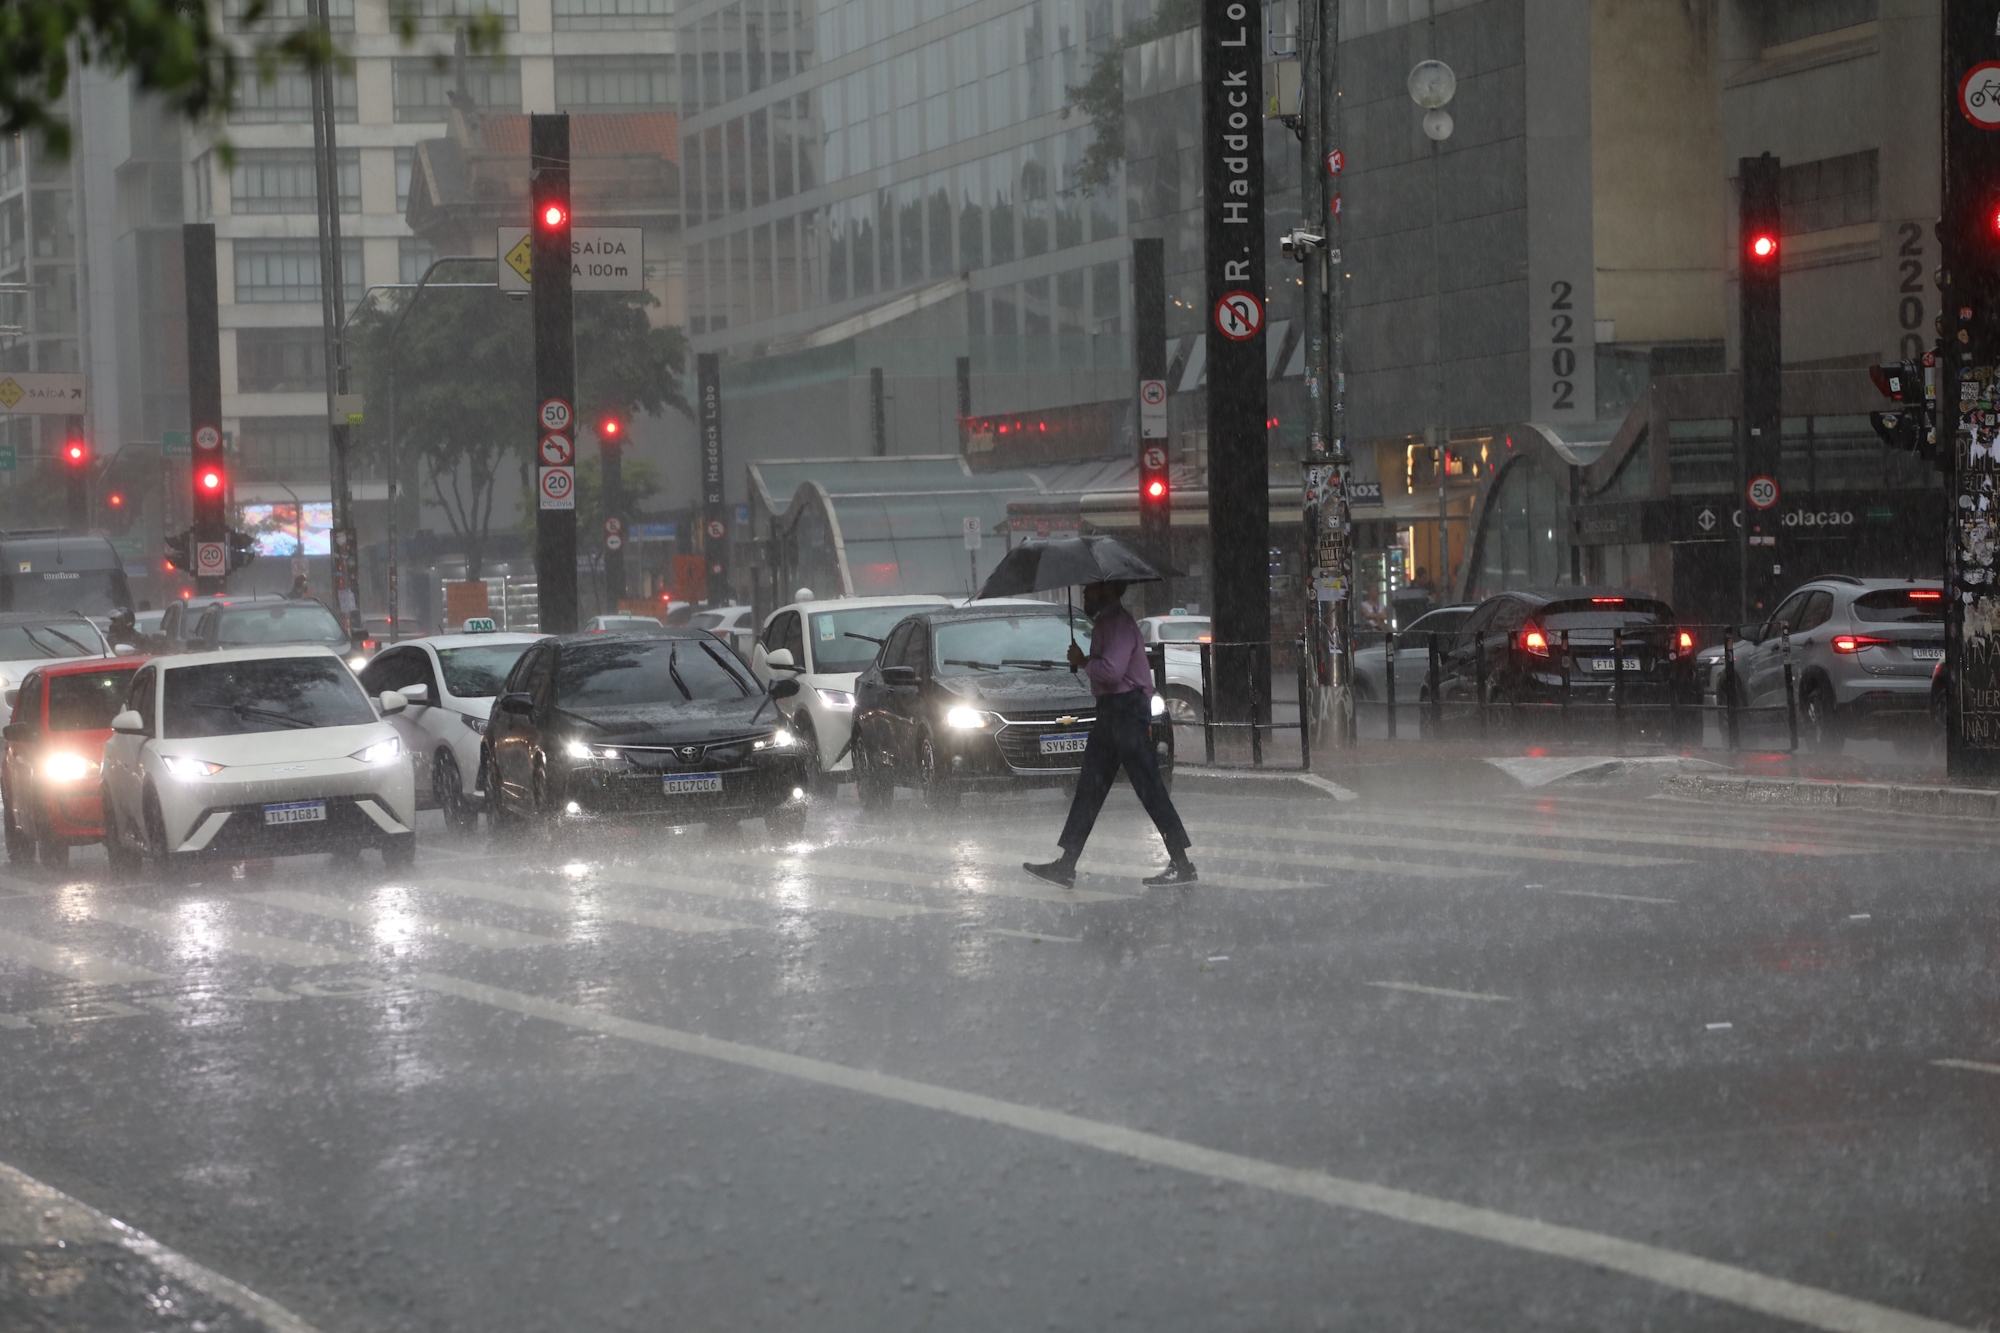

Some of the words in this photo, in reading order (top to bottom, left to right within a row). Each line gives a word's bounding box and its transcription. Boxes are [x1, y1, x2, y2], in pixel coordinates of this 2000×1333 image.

[1221, 3, 1247, 46] Lo
[1222, 70, 1249, 223] Haddock
[571, 238, 628, 254] SAÍDA
[589, 264, 629, 276] 100m
[1224, 246, 1250, 281] R.
[1550, 281, 1576, 410] 2202
[29, 387, 66, 398] SAÍDA
[705, 385, 716, 419] Lobo
[545, 405, 567, 421] 50
[707, 425, 719, 482] Haddock
[548, 476, 567, 489] 20
[709, 488, 720, 503] R.
[1752, 483, 1774, 498] 50
[203, 549, 219, 560] 20
[469, 620, 493, 631] TAXI
[1597, 660, 1636, 670] FTA35
[1046, 740, 1089, 752] SYW3B3
[269, 808, 320, 822] TLT1G81
